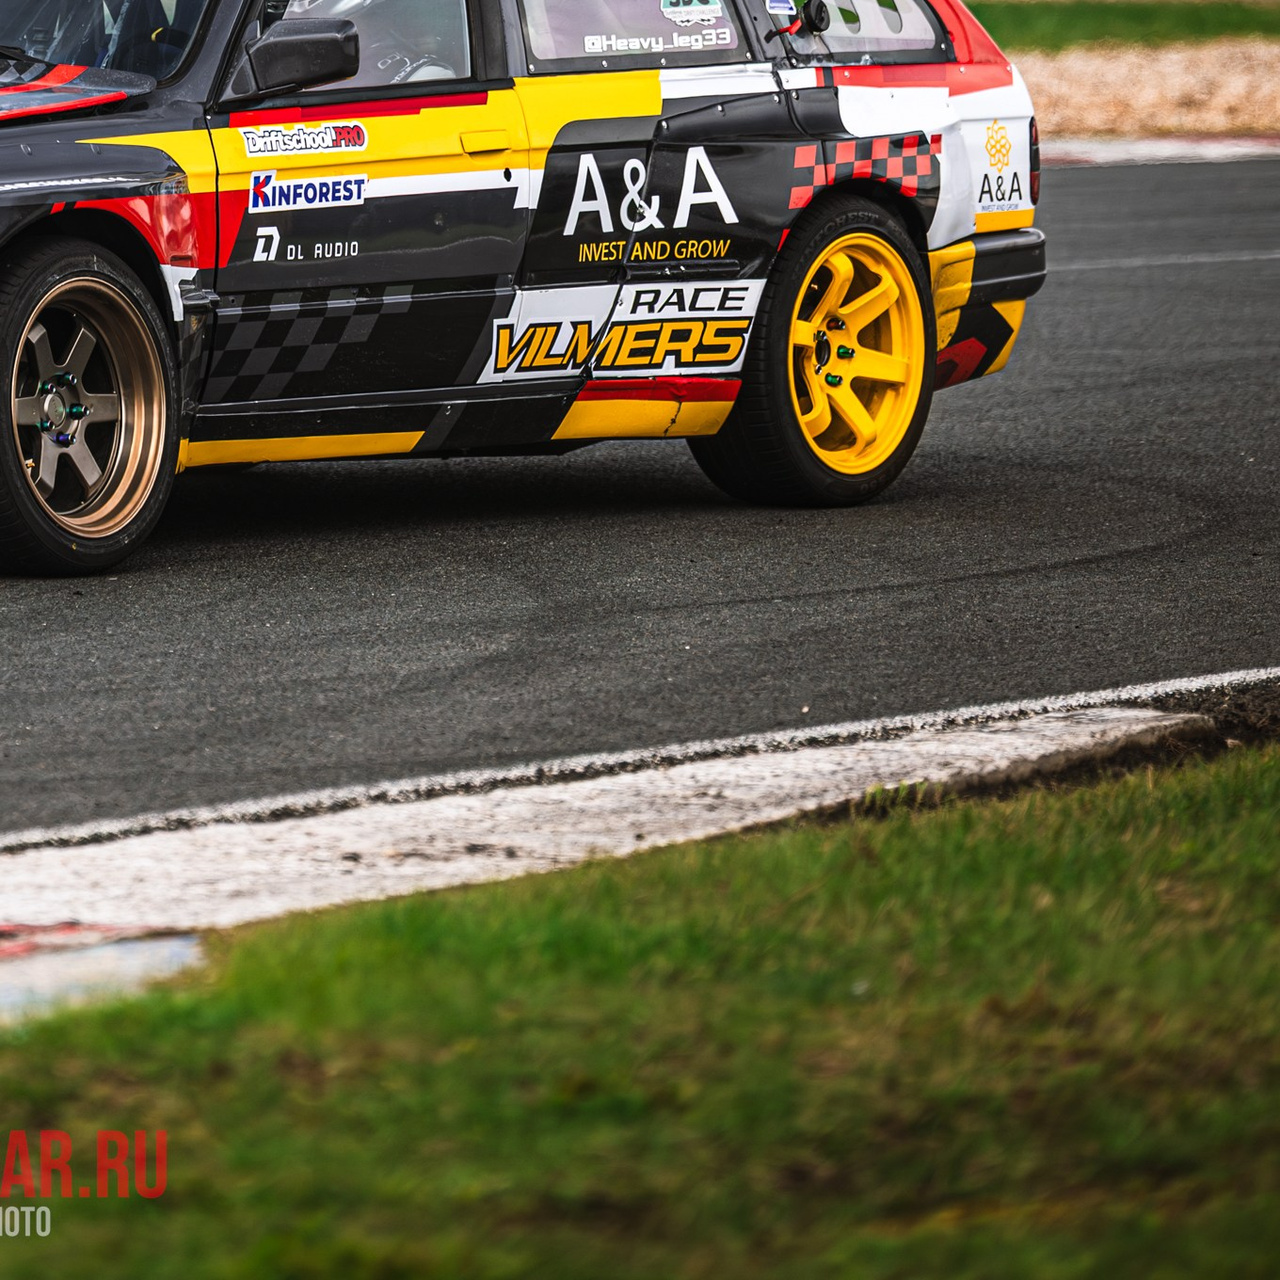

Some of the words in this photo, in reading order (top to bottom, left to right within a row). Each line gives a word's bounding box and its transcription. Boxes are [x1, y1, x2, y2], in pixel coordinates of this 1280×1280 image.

[584, 28, 730, 52] @Heavy_leg33
[243, 125, 365, 153] Driftschool.PRO
[252, 175, 365, 208] KINFOREST
[563, 146, 739, 236] A&A
[978, 172, 1022, 203] A&A
[287, 245, 304, 260] DL
[314, 241, 359, 259] AUDIO
[578, 241, 626, 262] INVEST
[631, 241, 670, 261] AND
[674, 239, 731, 258] GROW
[629, 286, 749, 314] RACE
[495, 319, 750, 371] VILMERS
